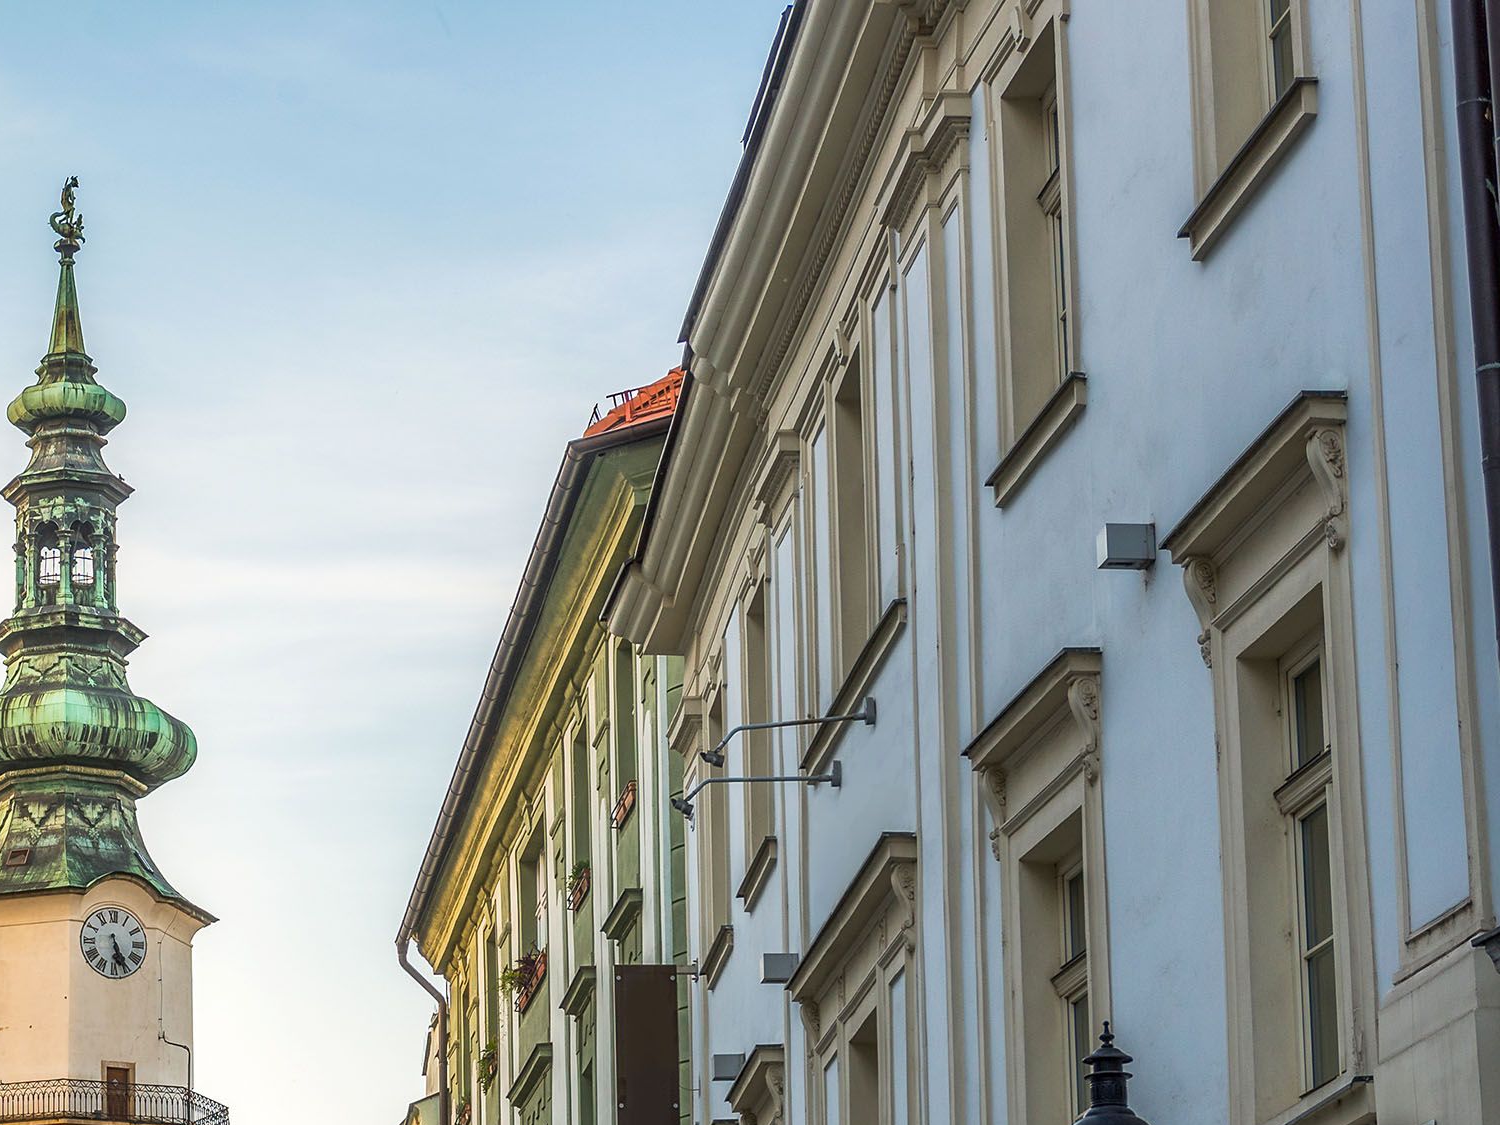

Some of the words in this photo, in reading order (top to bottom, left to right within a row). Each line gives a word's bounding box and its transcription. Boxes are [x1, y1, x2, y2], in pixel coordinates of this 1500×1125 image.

[96, 912, 107, 926] XI
[108, 910, 118, 923] XII
[122, 916, 130, 926] I
[87, 922, 99, 933] X
[129, 927, 141, 936] II
[84, 936, 96, 944] IX
